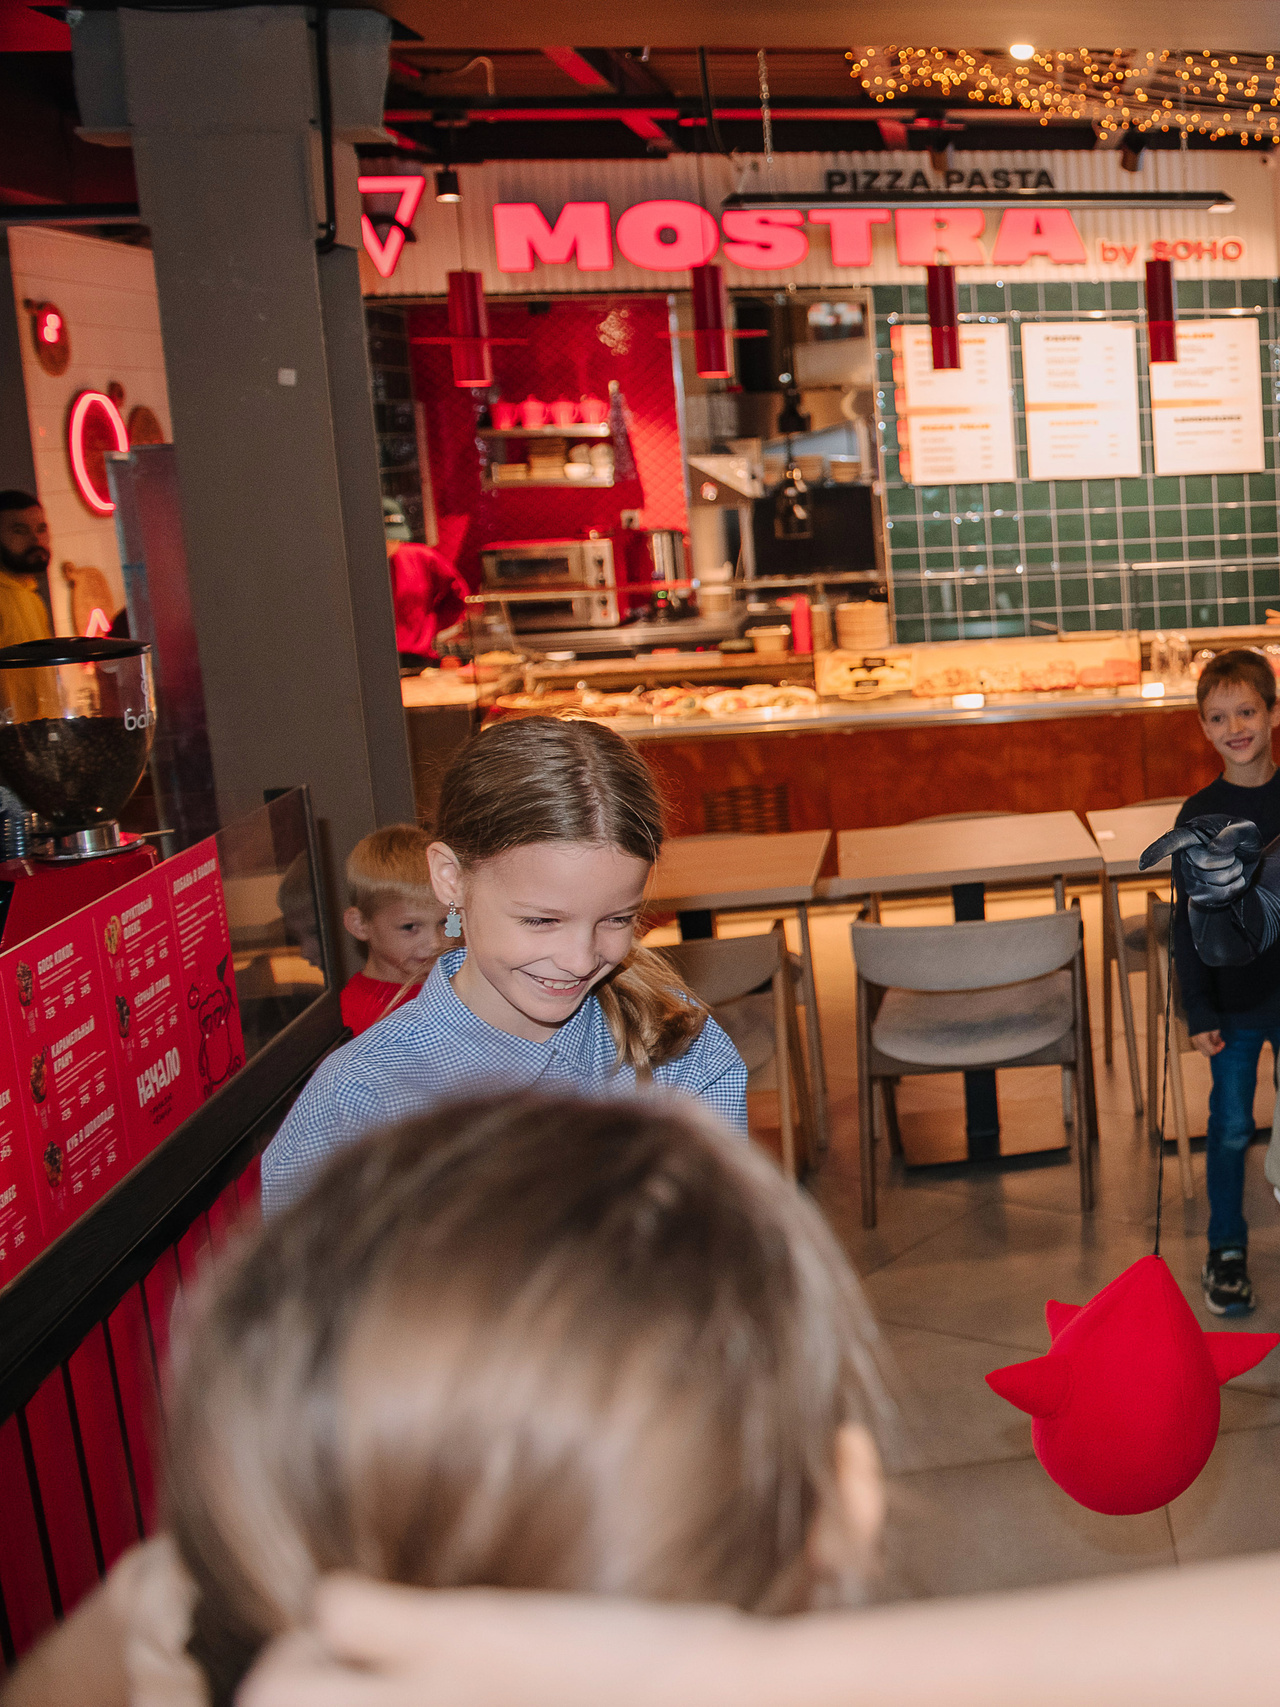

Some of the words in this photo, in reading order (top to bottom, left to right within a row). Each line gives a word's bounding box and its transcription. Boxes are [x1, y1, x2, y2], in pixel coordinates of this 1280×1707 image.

[826, 169, 930, 191] PIZZA
[945, 169, 1055, 190] PASTA
[493, 199, 1087, 272] MOSTRA
[1100, 240, 1138, 266] by
[1152, 240, 1243, 261] SOHO
